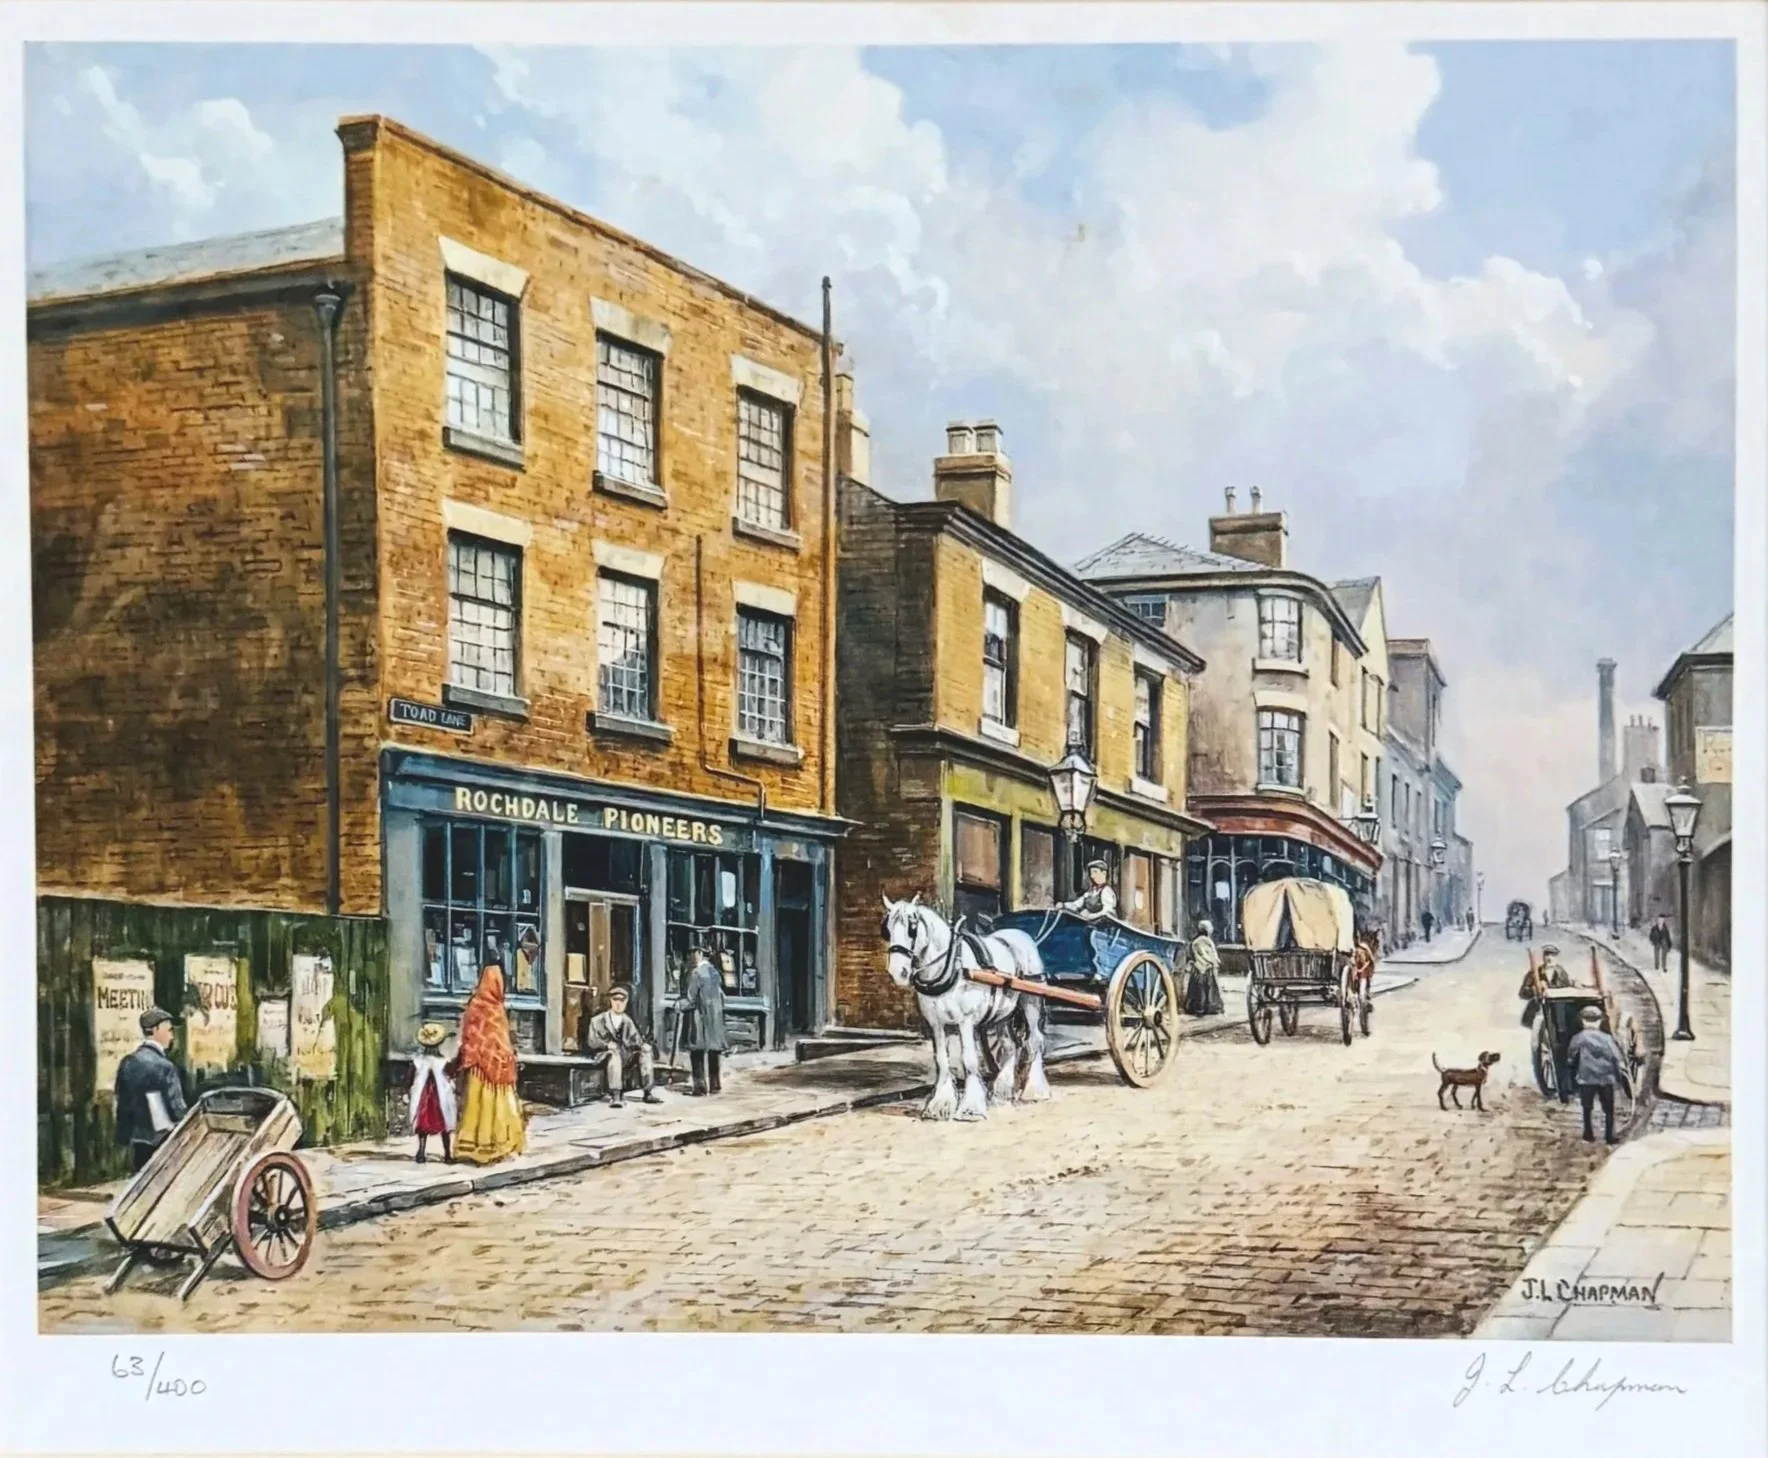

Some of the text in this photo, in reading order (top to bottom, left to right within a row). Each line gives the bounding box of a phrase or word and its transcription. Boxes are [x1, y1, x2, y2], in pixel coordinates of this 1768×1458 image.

[399, 703, 467, 727] TOAD LANE
[455, 786, 724, 846] ROCHDALE PIONEERS
[1556, 1271, 1665, 1304] CHAPMAN
[111, 1351, 207, 1402] 63/400
[1536, 1357, 1689, 1412] Chapman
